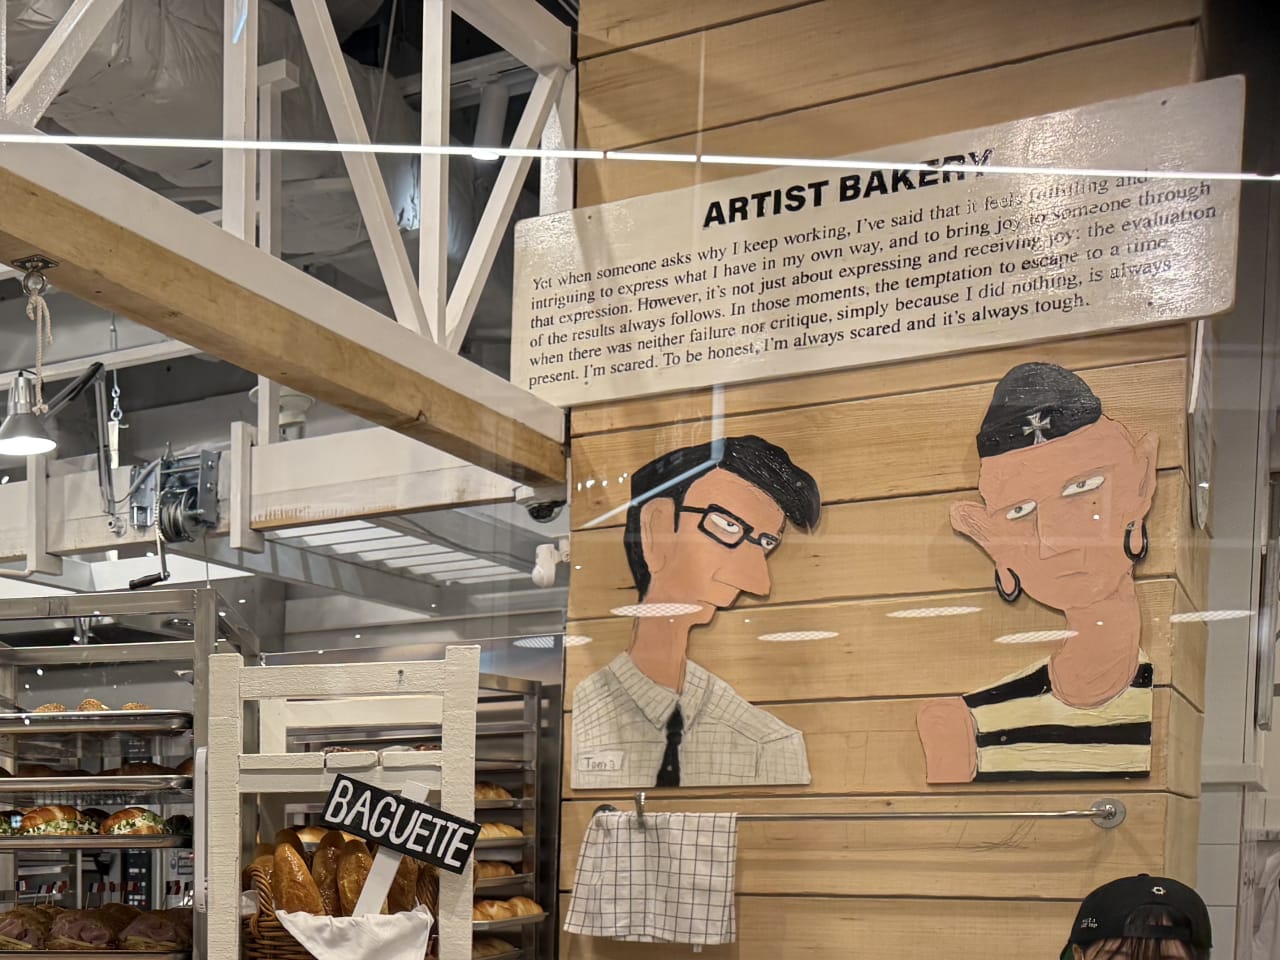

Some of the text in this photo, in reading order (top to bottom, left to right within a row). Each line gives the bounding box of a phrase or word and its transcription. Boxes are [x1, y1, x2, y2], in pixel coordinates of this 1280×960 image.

[702, 149, 994, 229] ARTIST BAKERY
[530, 314, 554, 330] that
[559, 302, 632, 326] expression.
[638, 290, 702, 312] However,
[706, 285, 727, 301] it's
[732, 281, 755, 296] not
[759, 276, 787, 294] just
[792, 268, 833, 286] about
[839, 255, 921, 285] expressing
[928, 247, 958, 264] and
[964, 233, 1041, 258] receiving
[1088, 221, 1115, 238] the
[1121, 205, 1217, 232] evaluation
[531, 289, 595, 311] intriguing
[600, 286, 613, 299] to
[618, 276, 669, 297] express
[674, 269, 708, 286] what
[712, 266, 718, 279] I
[723, 261, 757, 277] have
[762, 257, 777, 271] in
[783, 255, 805, 271] my
[811, 247, 843, 262] own
[849, 240, 884, 258] way,
[889, 229, 918, 247] and
[925, 228, 940, 241] to
[946, 221, 990, 239] bring
[994, 216, 1021, 236] joy
[1051, 197, 1131, 219] someone
[1138, 181, 1211, 208] through
[533, 276, 552, 291] Yet
[558, 269, 592, 287] when
[596, 258, 657, 280] someone
[661, 251, 692, 268] asks
[698, 246, 726, 264] why
[733, 241, 738, 256] I
[744, 236, 778, 256] keep
[784, 223, 851, 245] working,
[857, 217, 885, 234] I've
[891, 209, 923, 228] said
[930, 205, 961, 221] that
[529, 351, 564, 368] when
[569, 344, 602, 362] there
[606, 341, 632, 355] was
[638, 332, 684, 351] neither
[690, 323, 737, 342] failure
[741, 323, 765, 337] nor
[770, 310, 833, 333] critique,
[837, 301, 888, 323] simply
[895, 289, 960, 313] because
[966, 286, 972, 301] I
[978, 281, 1006, 299] did
[1012, 271, 1082, 294] nothing,
[1089, 268, 1103, 282] is
[529, 292, 1090, 389] present. I'm scared. To be honest, I'm always scared and it's always tough.
[530, 332, 545, 348] of
[548, 329, 568, 345] the
[572, 322, 615, 342] results
[620, 317, 666, 336] always
[670, 304, 726, 326] follows.
[731, 302, 748, 318] In
[752, 295, 791, 314] those
[795, 286, 870, 308] moments,
[875, 277, 900, 293] the
[905, 264, 993, 290] temptation
[1000, 260, 1015, 274] to
[1021, 250, 1078, 274] escape
[1087, 246, 1104, 260] to
[1110, 244, 1120, 256] a
[325, 780, 476, 867] BAGUETTE
